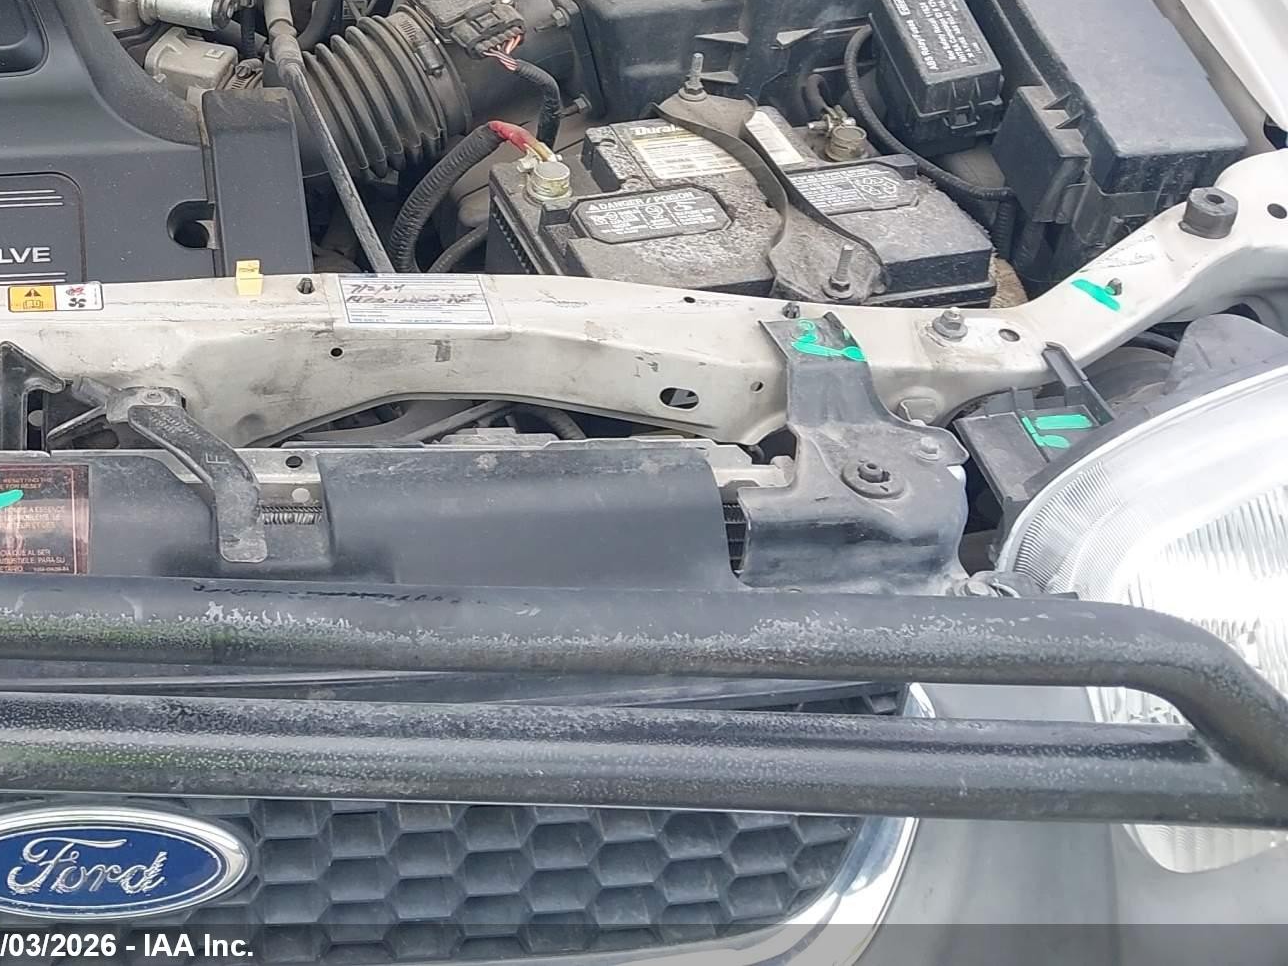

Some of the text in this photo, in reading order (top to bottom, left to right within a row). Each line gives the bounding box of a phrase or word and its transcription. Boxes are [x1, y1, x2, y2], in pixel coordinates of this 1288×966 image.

[598, 198, 643, 210] DANGER
[653, 191, 694, 203] POISON
[7, 837, 168, 894] Ford
